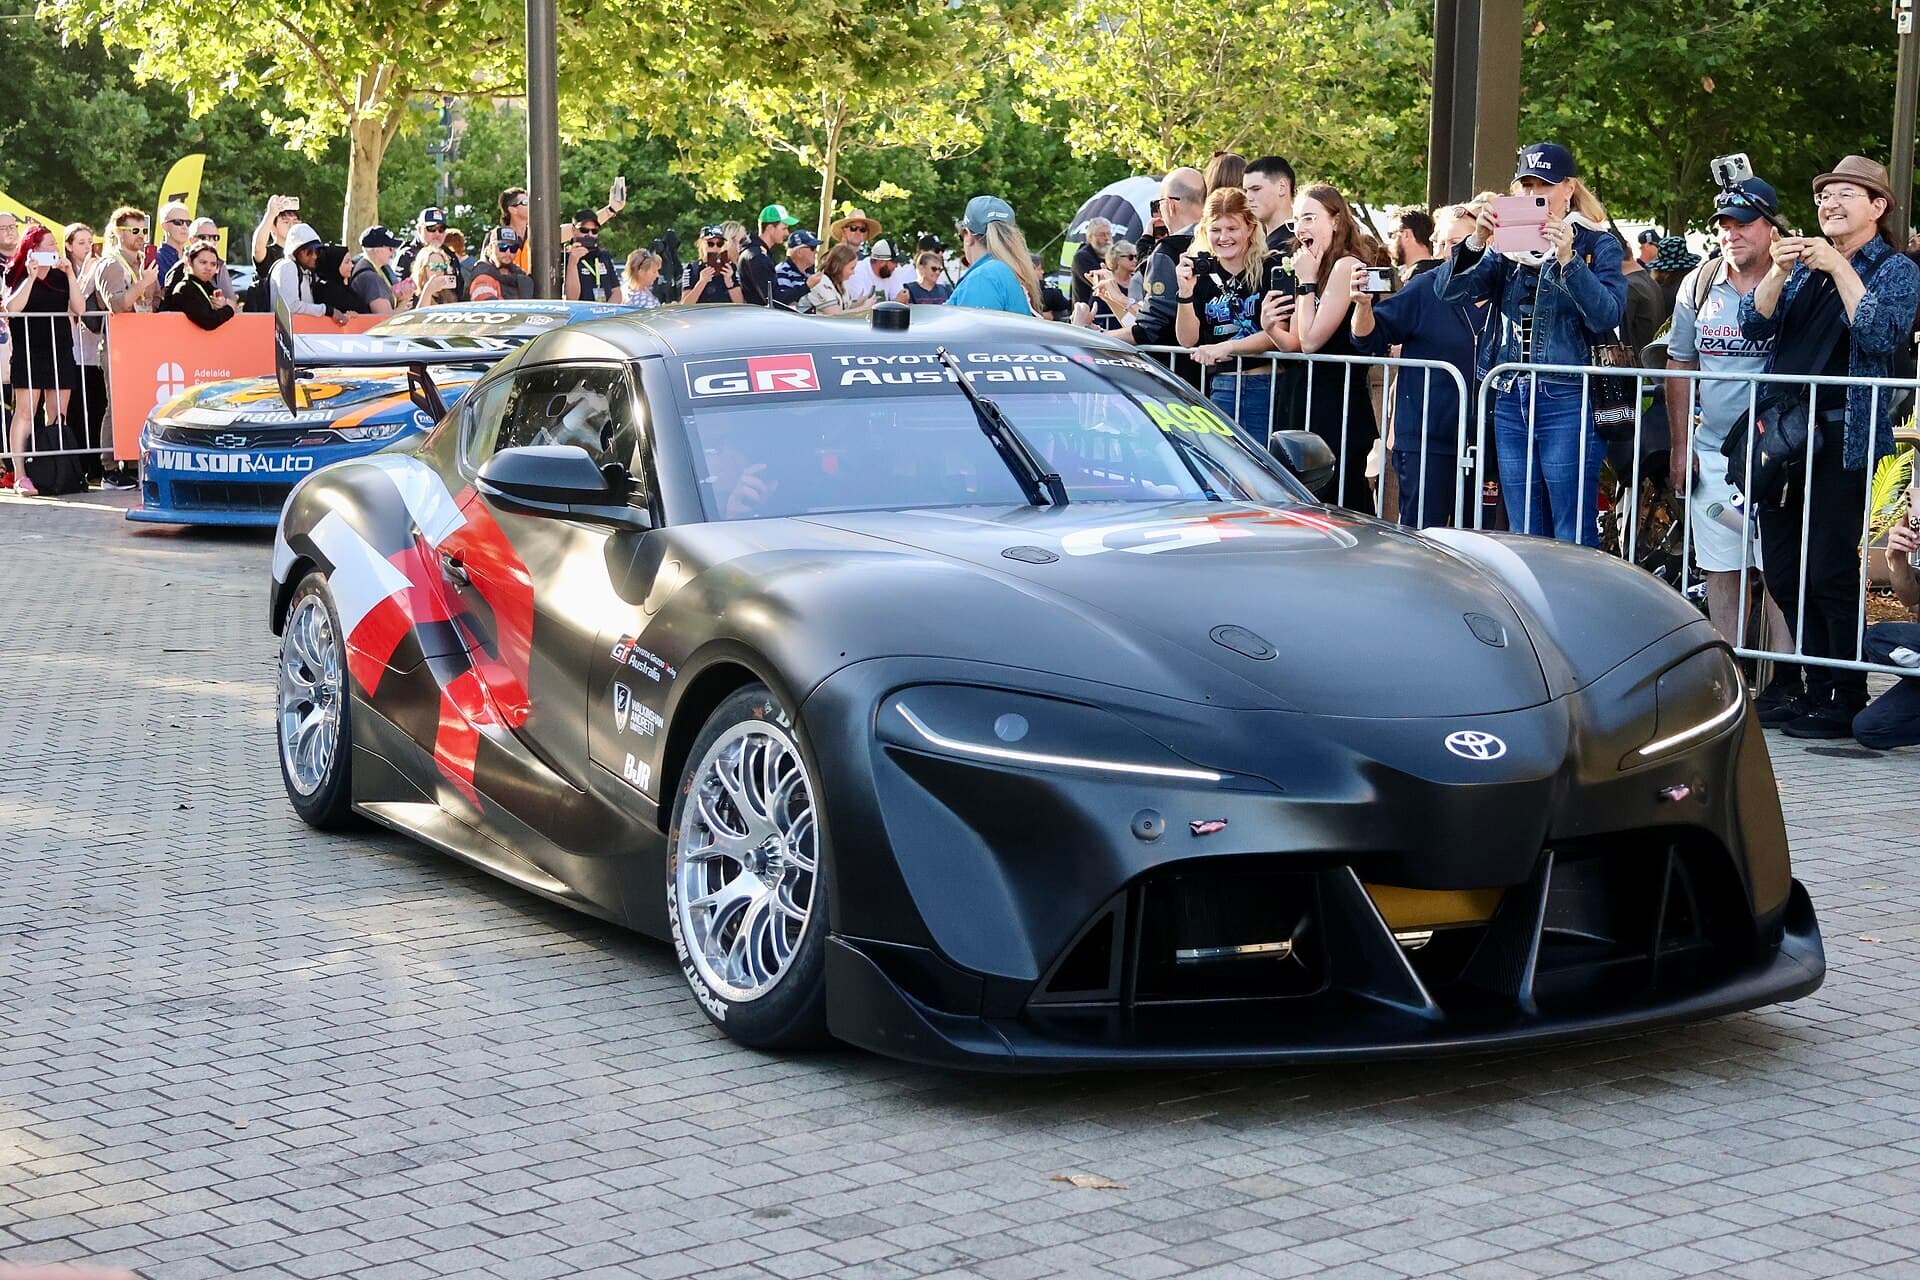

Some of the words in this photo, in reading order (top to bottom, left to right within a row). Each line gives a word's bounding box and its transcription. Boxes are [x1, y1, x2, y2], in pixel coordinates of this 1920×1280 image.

[423, 312, 512, 325] TRICO
[1702, 325, 1721, 337] Red
[1722, 326, 1743, 338] Bul
[194, 368, 231, 378] Adelaide
[968, 352, 1069, 364] GAZOO
[1072, 354, 1156, 373] Racing
[694, 368, 817, 395] GR
[839, 366, 1067, 386] Australia
[1142, 402, 1234, 437] A90
[628, 654, 660, 682] Australia
[623, 752, 651, 791] BJR
